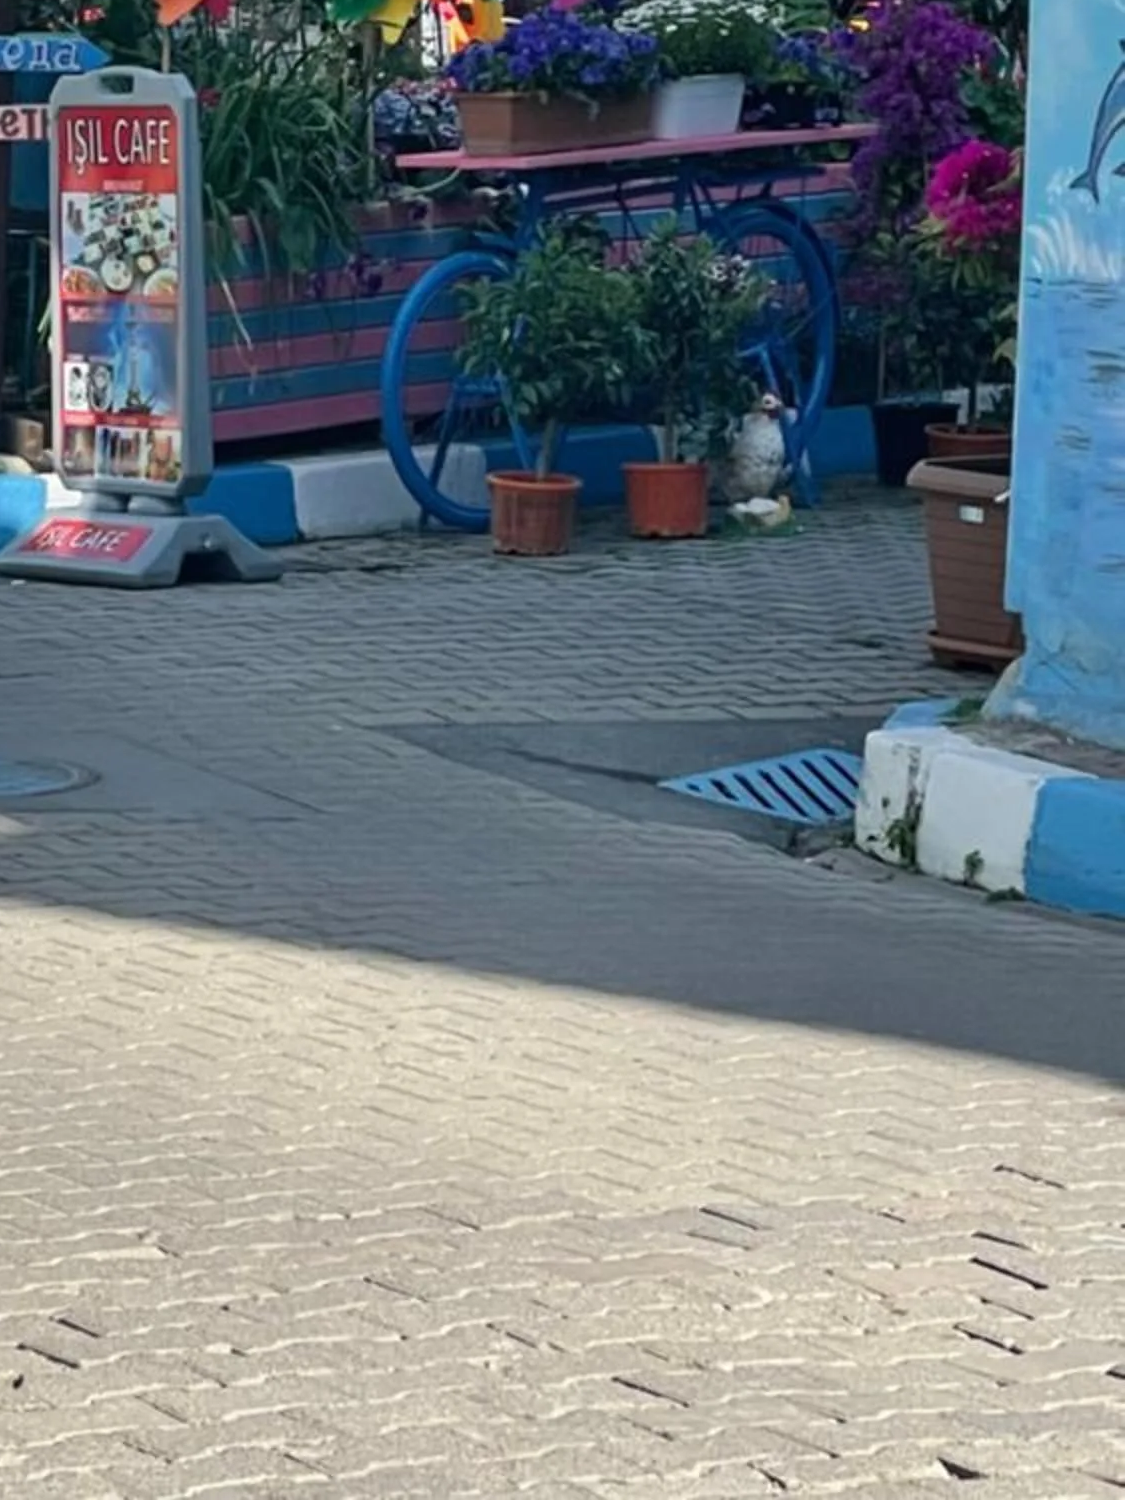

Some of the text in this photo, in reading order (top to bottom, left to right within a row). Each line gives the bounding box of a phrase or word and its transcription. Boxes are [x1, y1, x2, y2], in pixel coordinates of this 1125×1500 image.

[66, 118, 171, 176] IŞIL CAFE
[69, 528, 129, 551] CAFE
